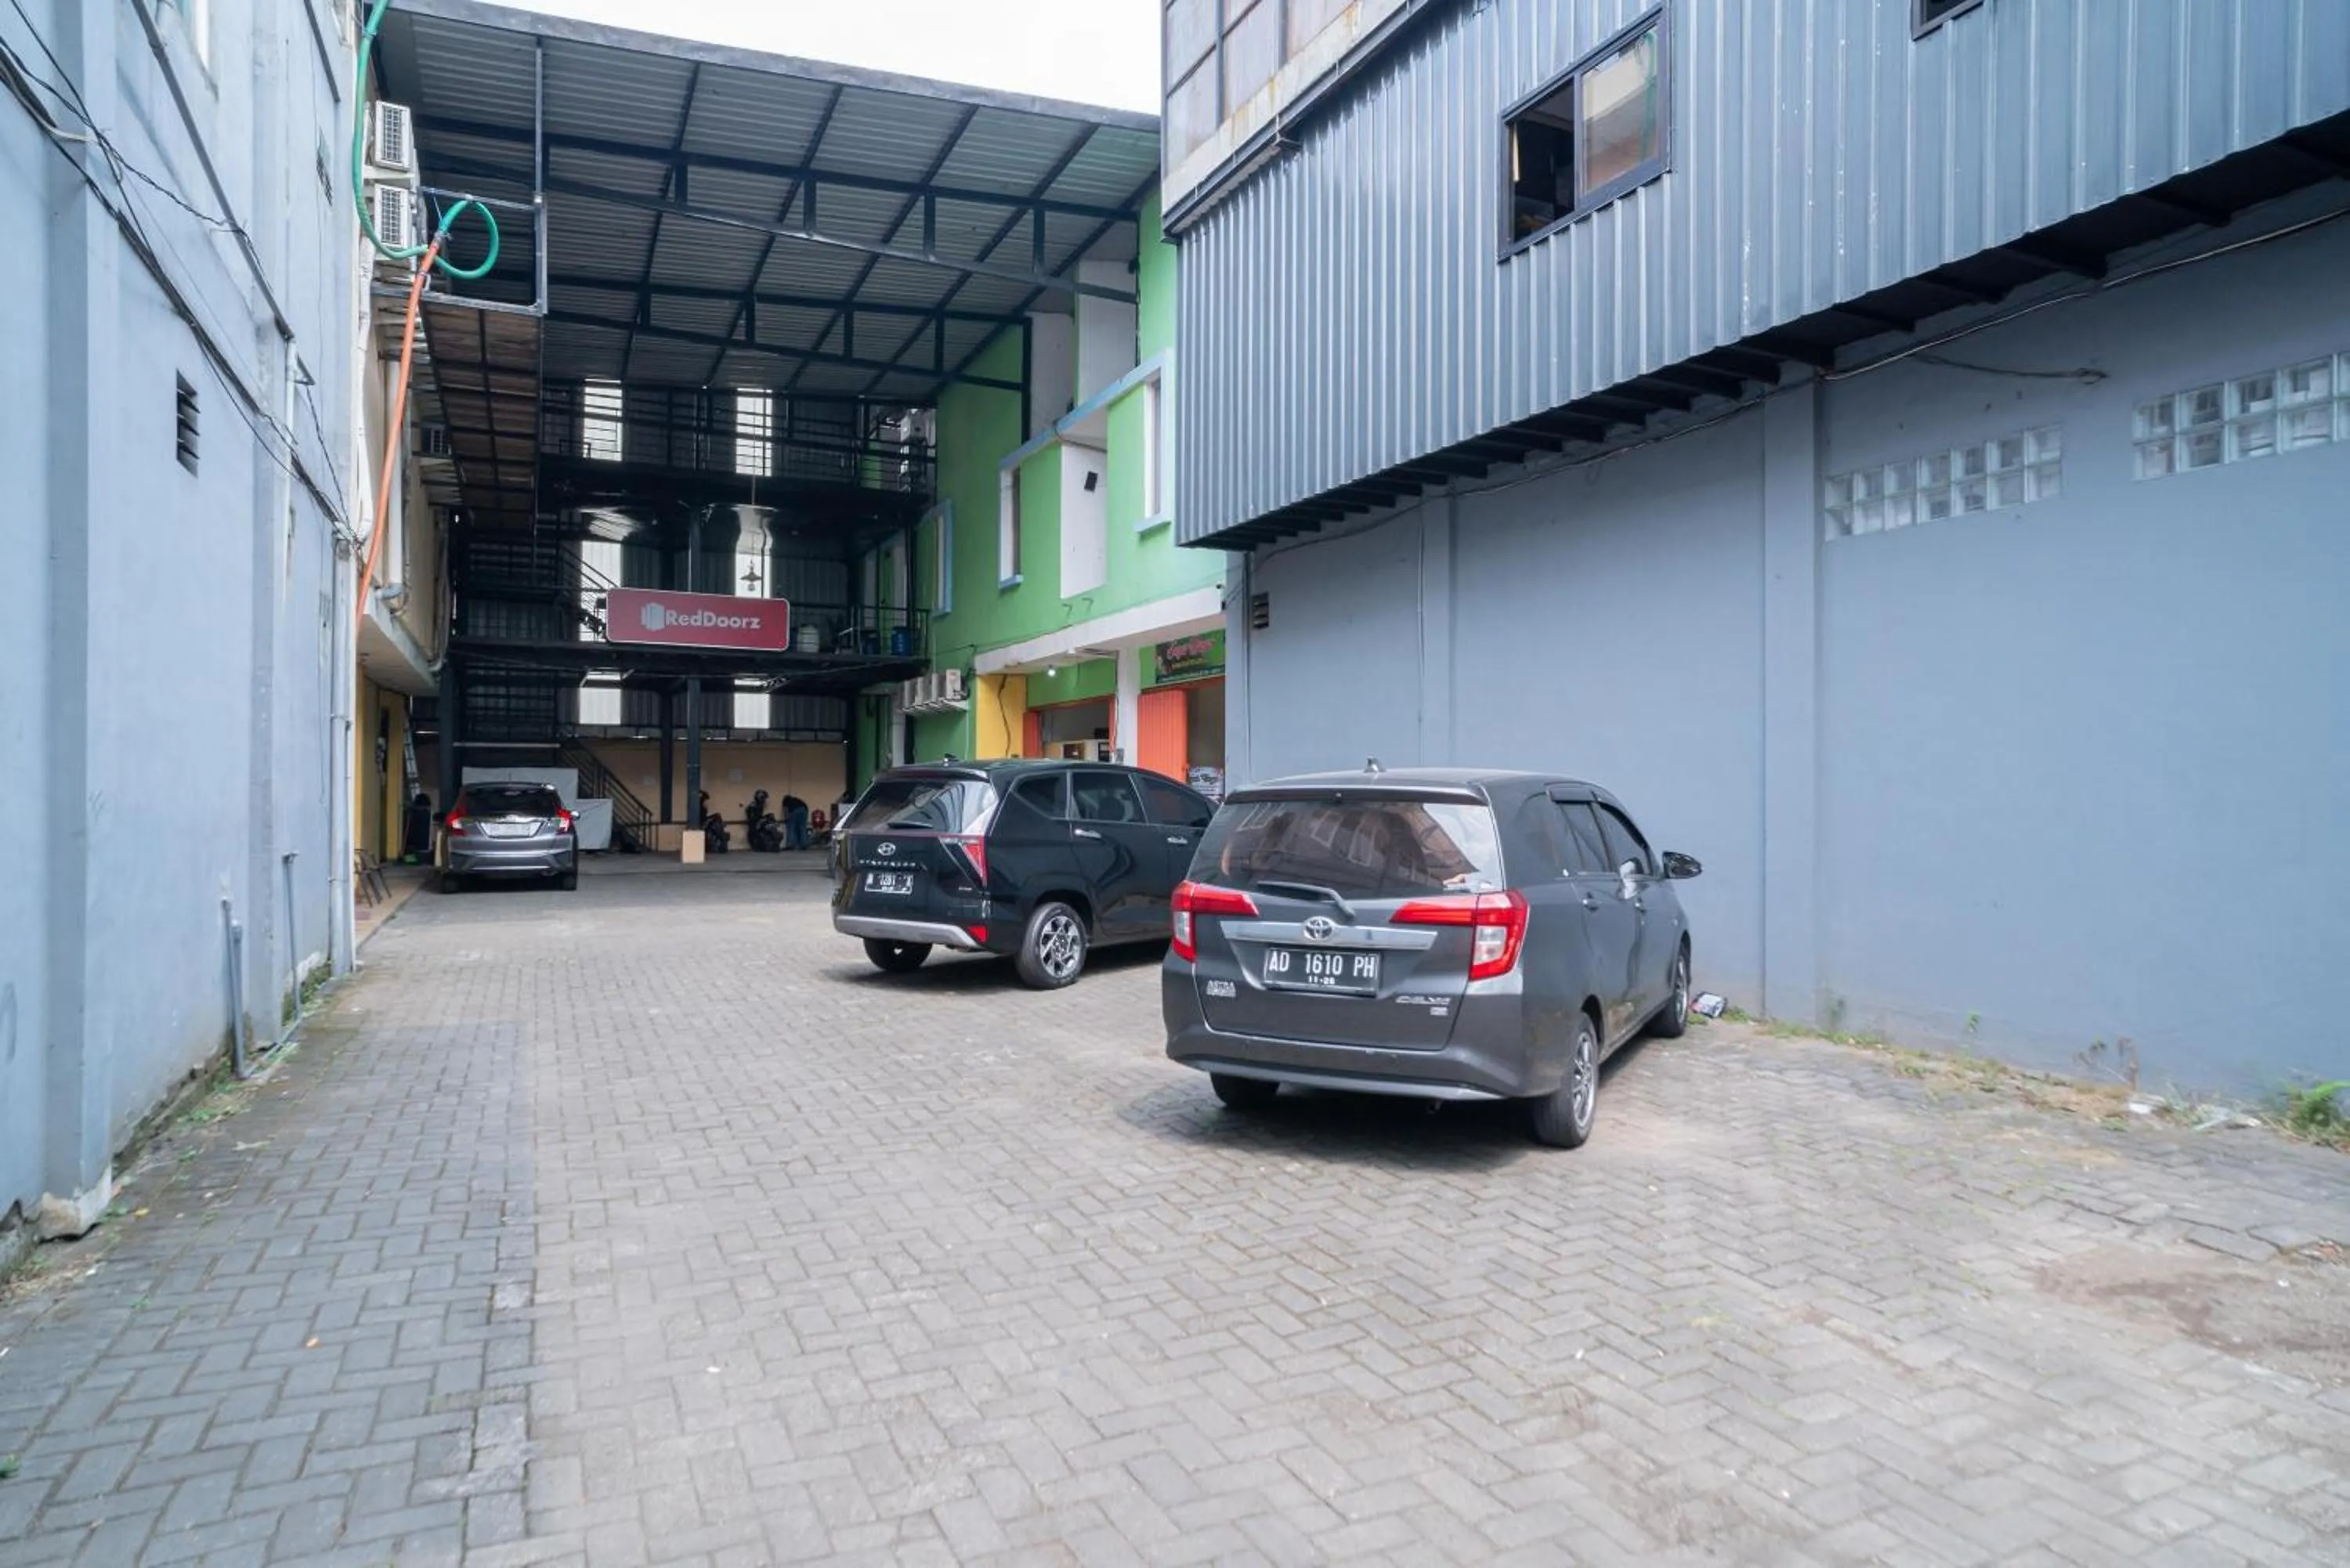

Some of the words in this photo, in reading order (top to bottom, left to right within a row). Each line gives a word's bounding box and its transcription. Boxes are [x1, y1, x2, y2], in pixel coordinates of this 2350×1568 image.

[666, 609, 761, 629] RedDoorz
[1268, 950, 1290, 972] AD
[1305, 953, 1343, 976] 1610
[1353, 956, 1375, 978] PH
